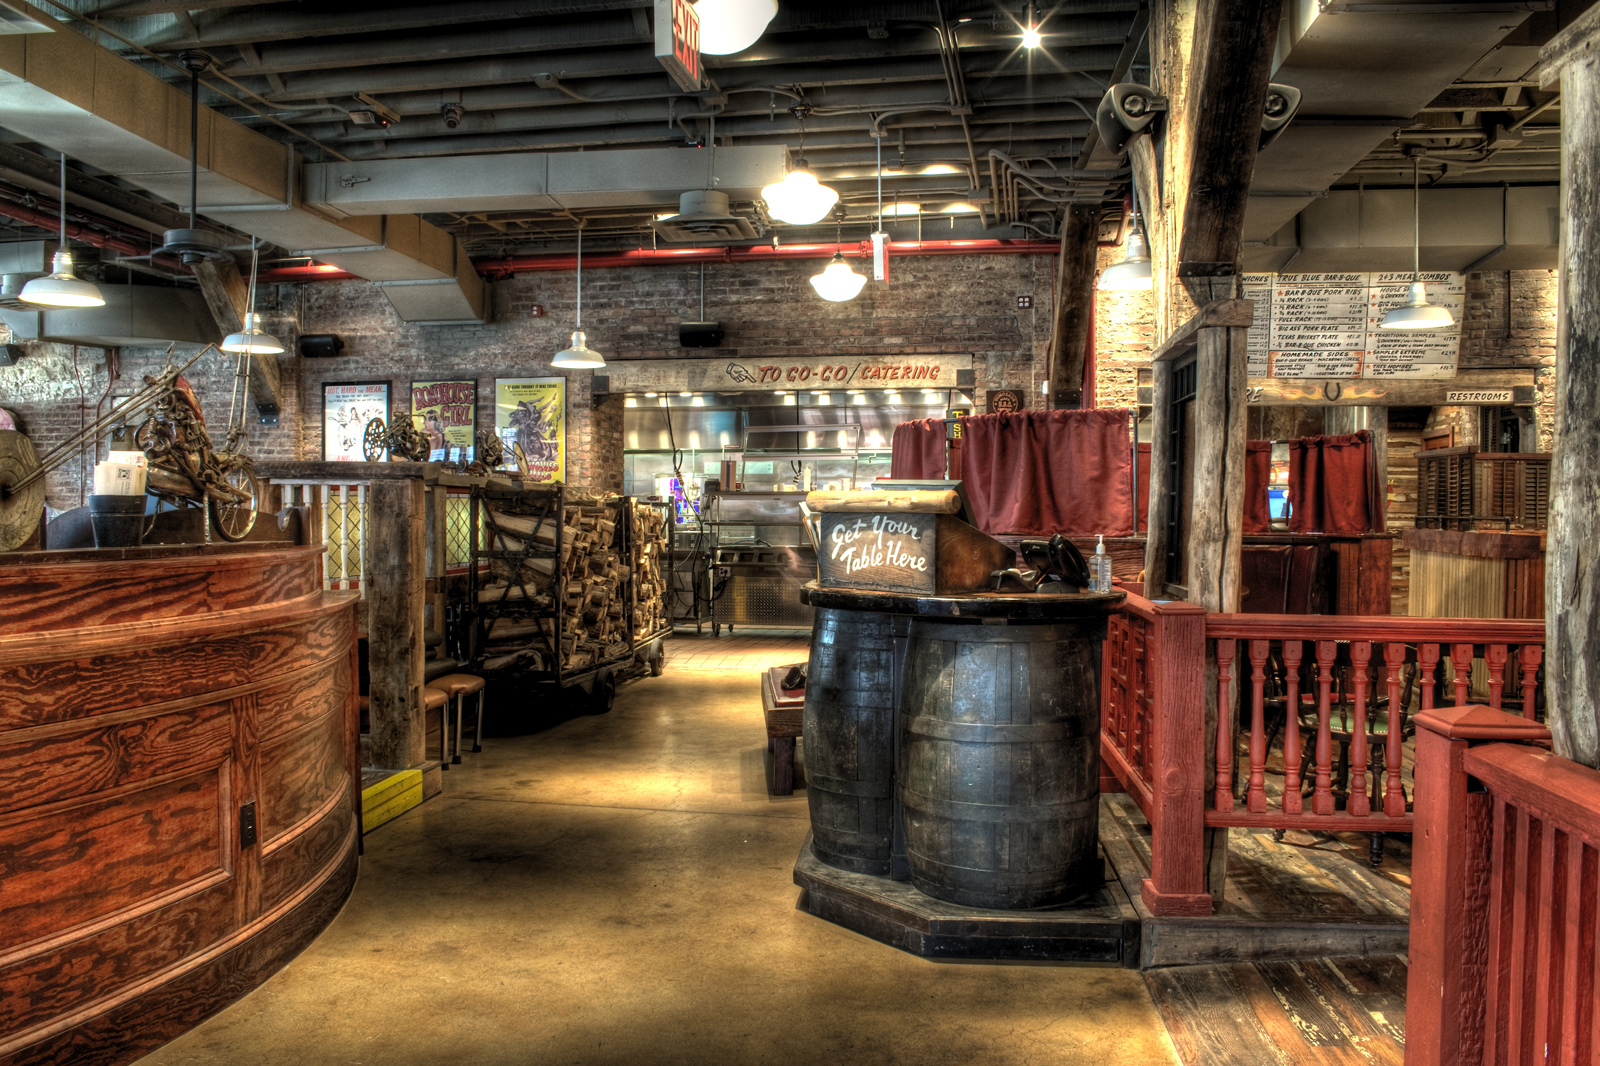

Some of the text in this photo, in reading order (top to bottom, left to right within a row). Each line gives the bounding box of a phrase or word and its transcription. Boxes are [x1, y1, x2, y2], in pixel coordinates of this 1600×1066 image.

[675, 0, 698, 80] EXIT
[1278, 274, 1299, 282] TRUE
[759, 365, 782, 383] TO
[412, 383, 475, 411] ROADHOUSE
[1449, 392, 1509, 400] RESTROOMS
[440, 404, 472, 427] GIRL
[831, 515, 921, 560] Get Your
[840, 540, 928, 574] Table Here
